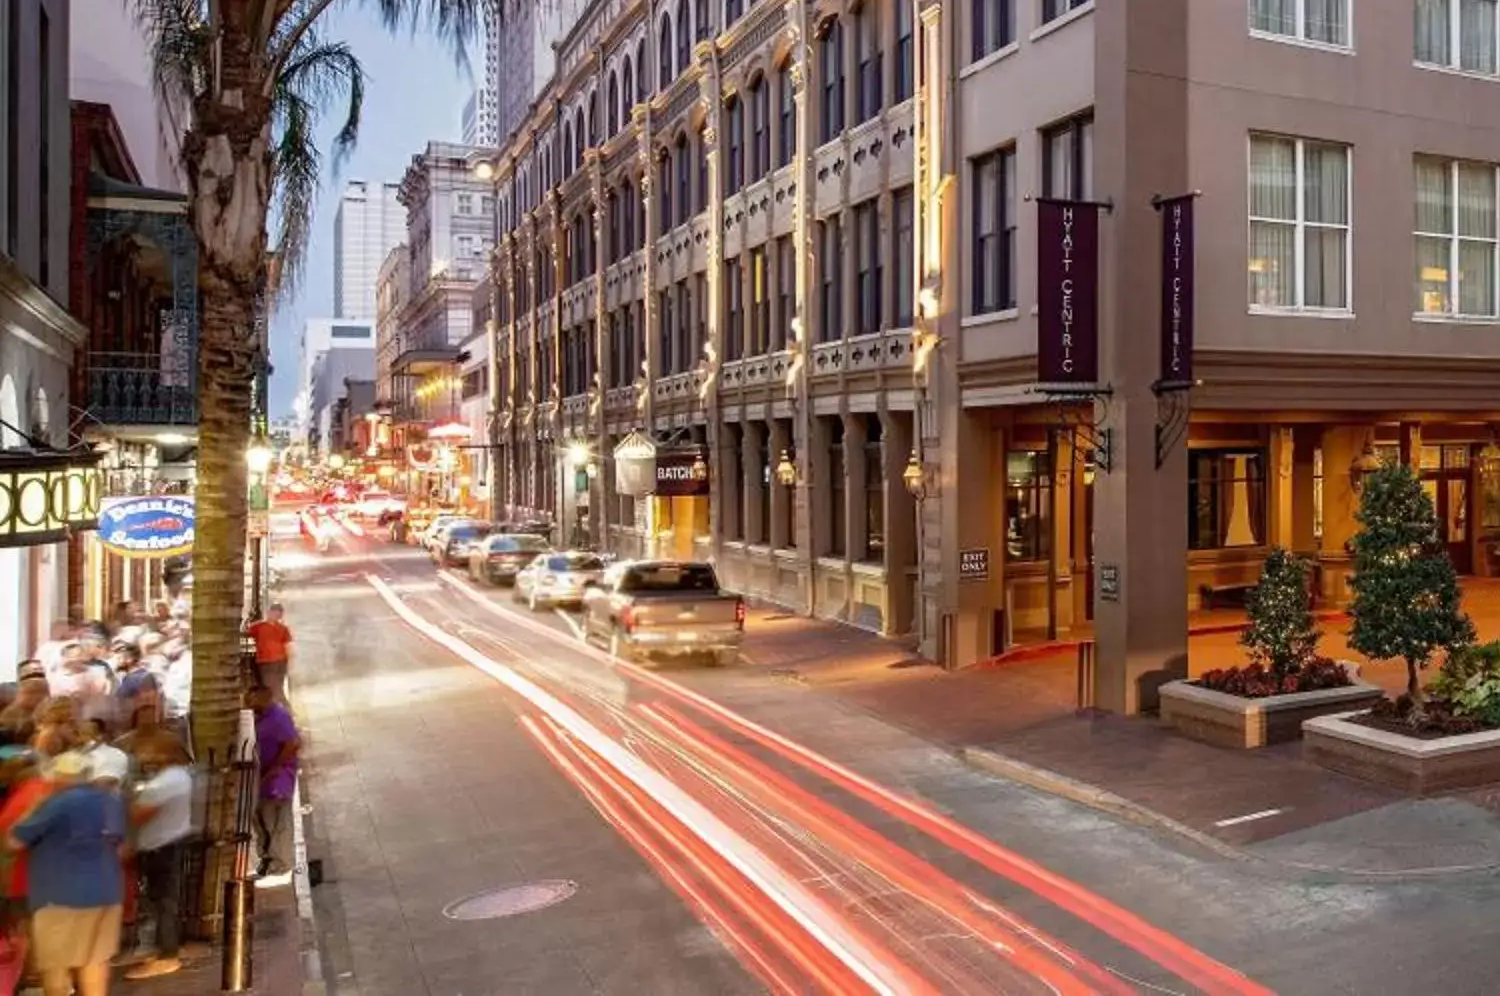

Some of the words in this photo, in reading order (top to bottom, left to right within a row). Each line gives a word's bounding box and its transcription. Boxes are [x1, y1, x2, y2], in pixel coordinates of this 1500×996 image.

[1062, 207, 1073, 272] HYATT
[1173, 205, 1181, 270] HYATT
[1061, 279, 1073, 373] CENTRIC
[1171, 277, 1181, 371] CENTRIC
[657, 466, 695, 480] BATCH
[961, 562, 986, 572] ONLY
[963, 553, 984, 562] EXIT
